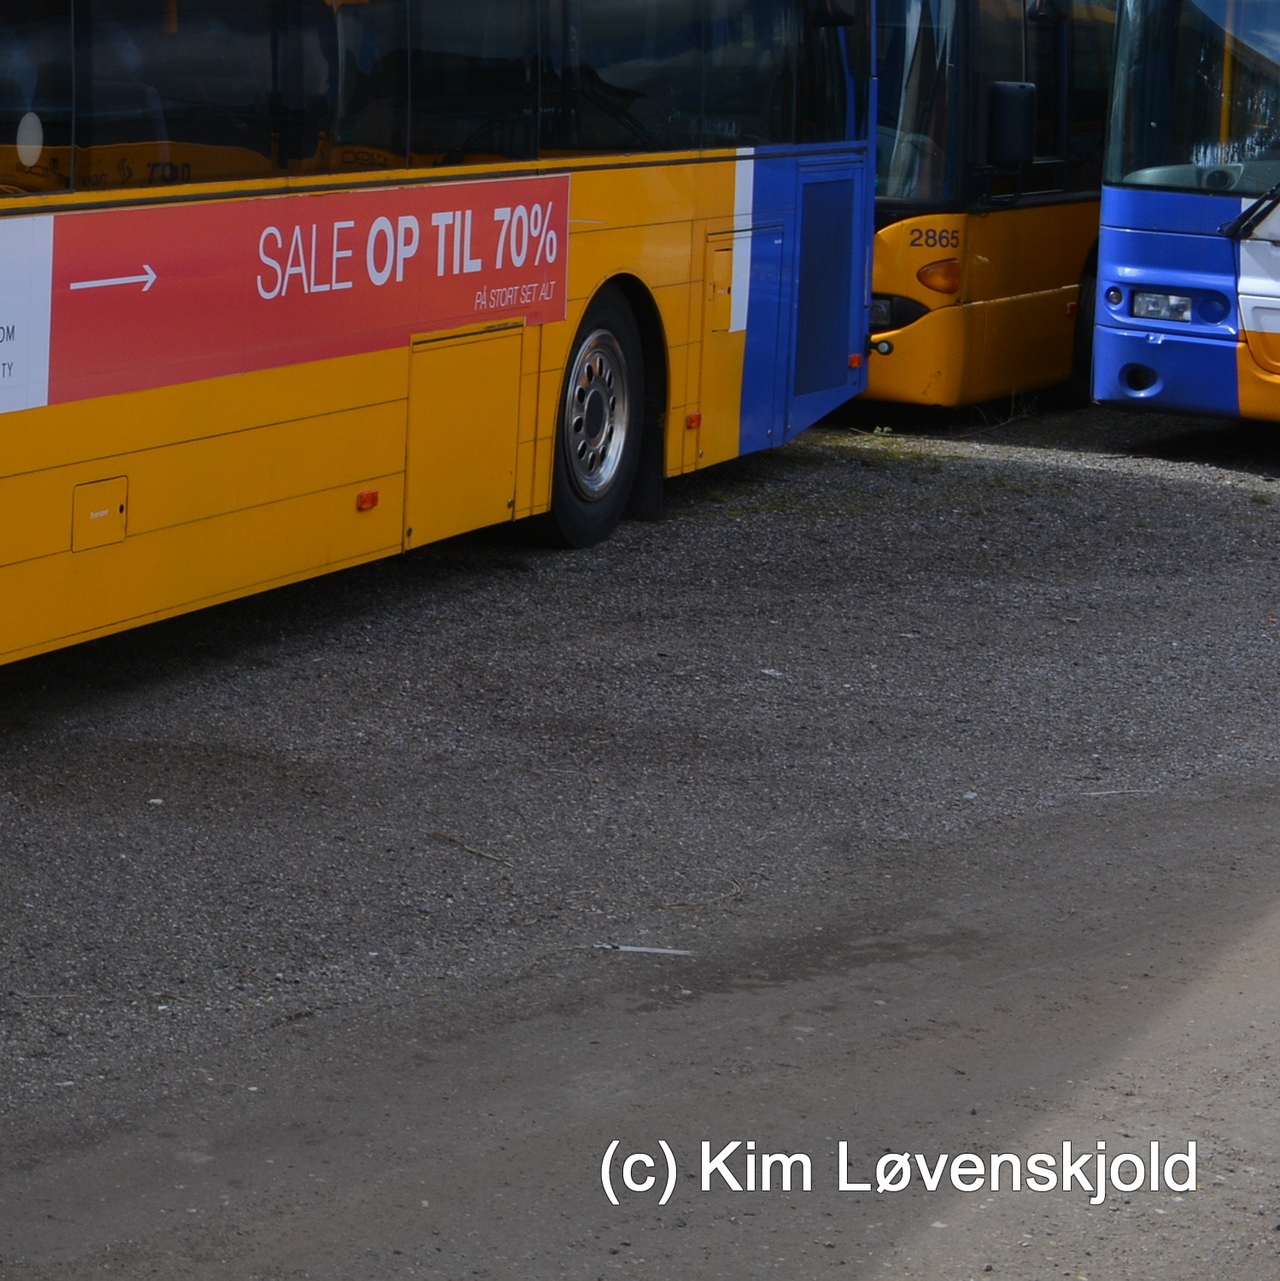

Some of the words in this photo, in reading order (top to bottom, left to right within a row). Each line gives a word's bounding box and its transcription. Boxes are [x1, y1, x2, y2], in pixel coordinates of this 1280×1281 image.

[256, 220, 355, 300] SALE
[366, 216, 420, 286] OP
[431, 209, 482, 277] TIL
[493, 201, 558, 269] 70%
[909, 228, 960, 248] 2865
[474, 285, 488, 311] PÅ
[488, 286, 520, 309] STORT
[520, 283, 539, 304] SET
[539, 281, 556, 301] ALT
